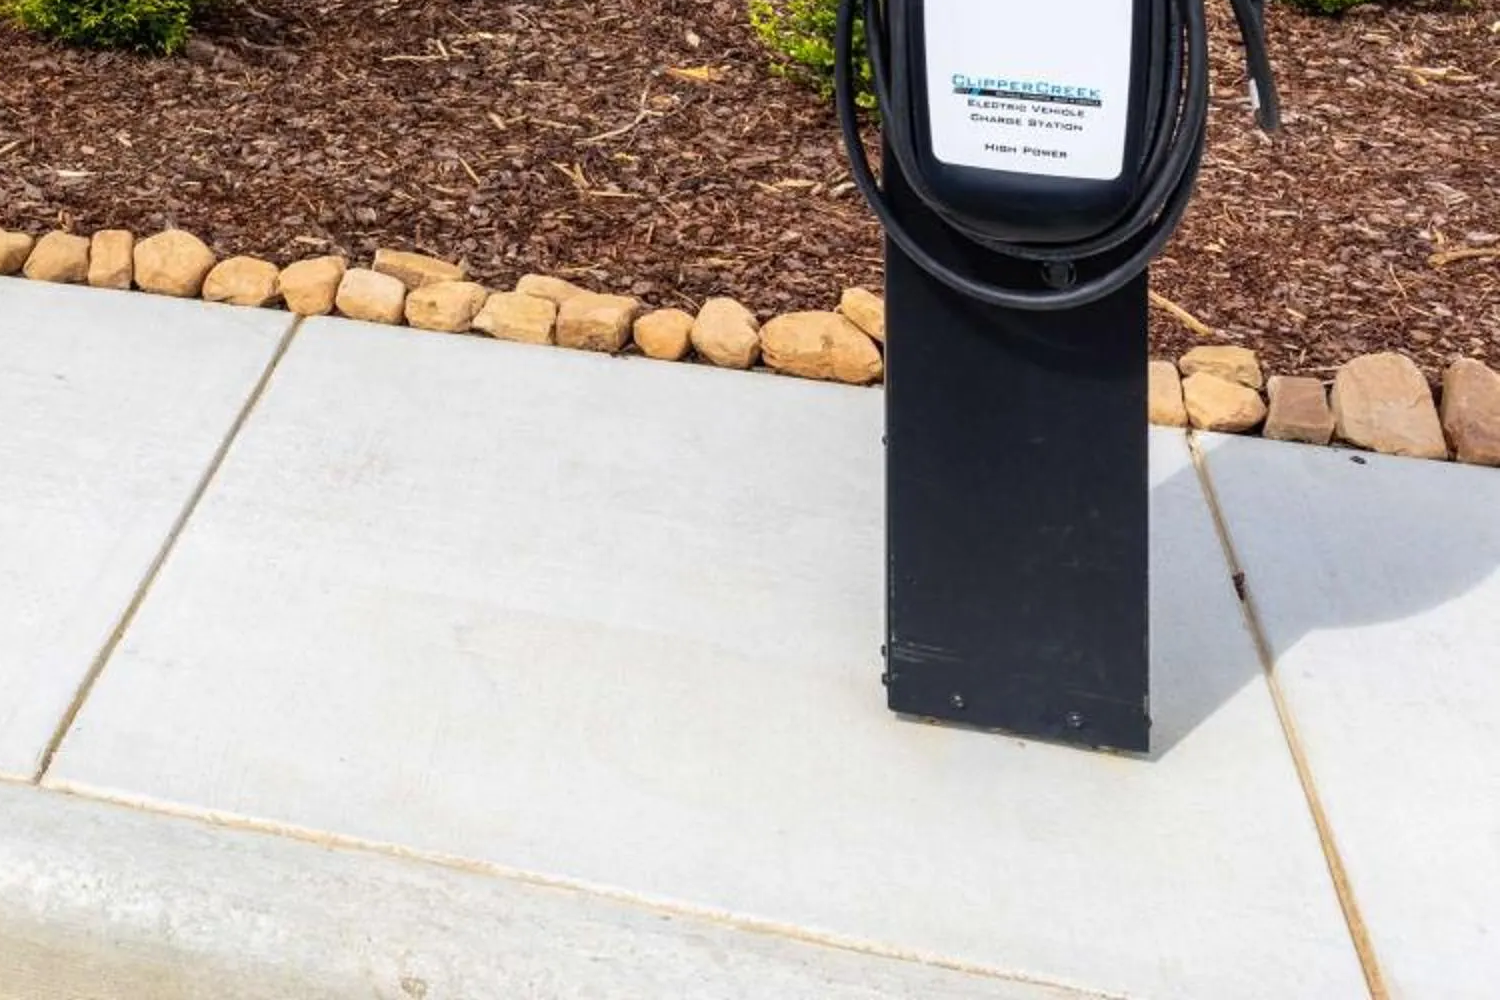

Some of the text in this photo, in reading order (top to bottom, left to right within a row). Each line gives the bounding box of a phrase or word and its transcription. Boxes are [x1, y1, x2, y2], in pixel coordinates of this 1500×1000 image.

[967, 99, 1085, 118] ELECTRIC VEHICLE
[970, 113, 1083, 131] CHARGE STATION
[984, 143, 1068, 158] HIGH POWER
